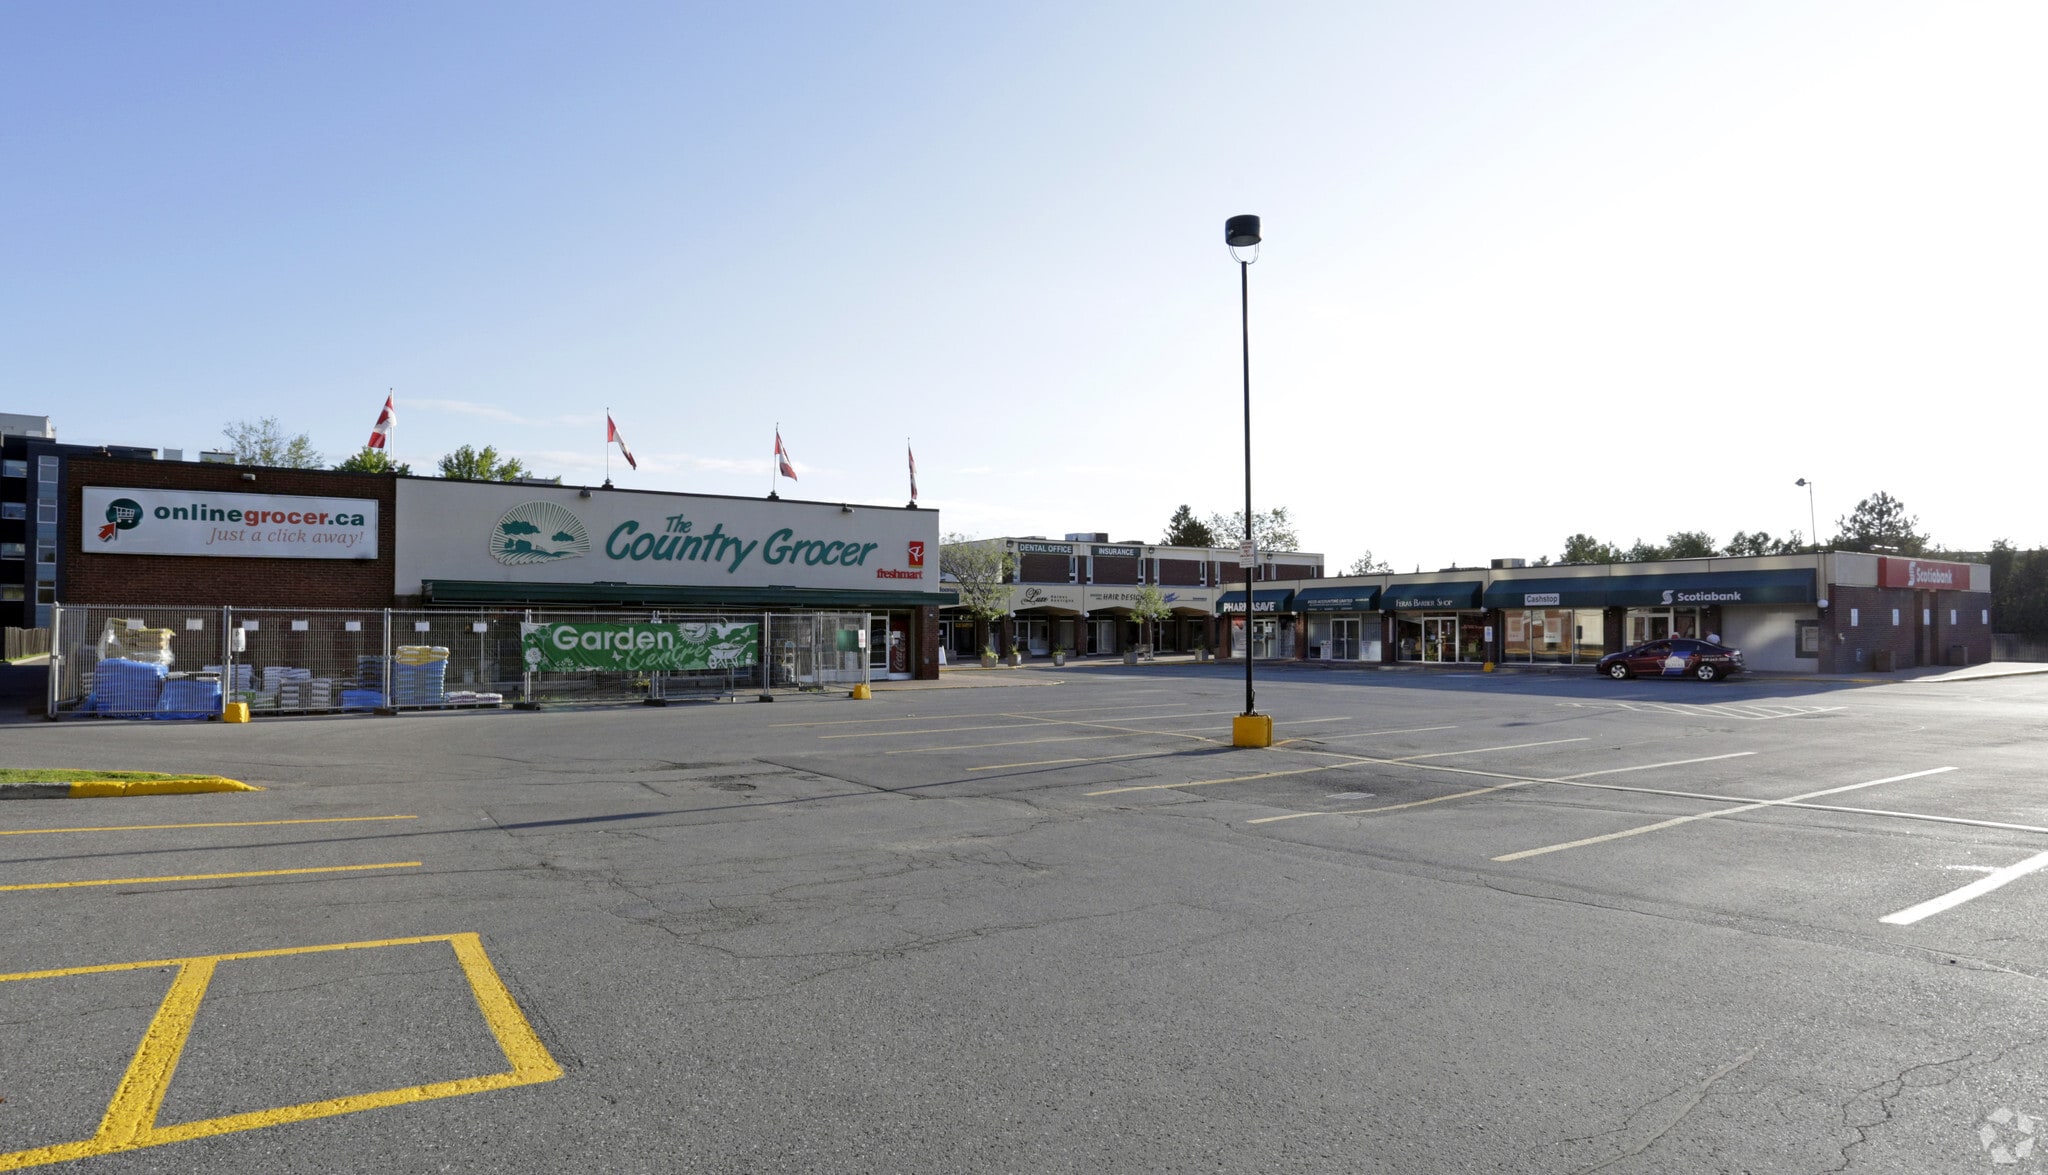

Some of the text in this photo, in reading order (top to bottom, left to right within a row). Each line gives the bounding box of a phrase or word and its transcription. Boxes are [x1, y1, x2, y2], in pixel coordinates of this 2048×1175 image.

[154, 504, 365, 526] onlinegrocer.ca
[666, 514, 692, 534] The
[206, 527, 364, 547] Just a click away!
[605, 520, 878, 573] Country Grocer
[1019, 543, 1072, 553] DENTAL OFFICE
[1098, 547, 1135, 556] INSURANCE
[876, 568, 923, 579] freshmart
[1916, 567, 1953, 584] Scotiabank
[1103, 593, 1119, 601] HAIR
[1526, 595, 1558, 604] Cashstop
[1677, 591, 1742, 602] Scotiabank
[552, 625, 674, 651] Garden
[625, 641, 708, 671] Centre
